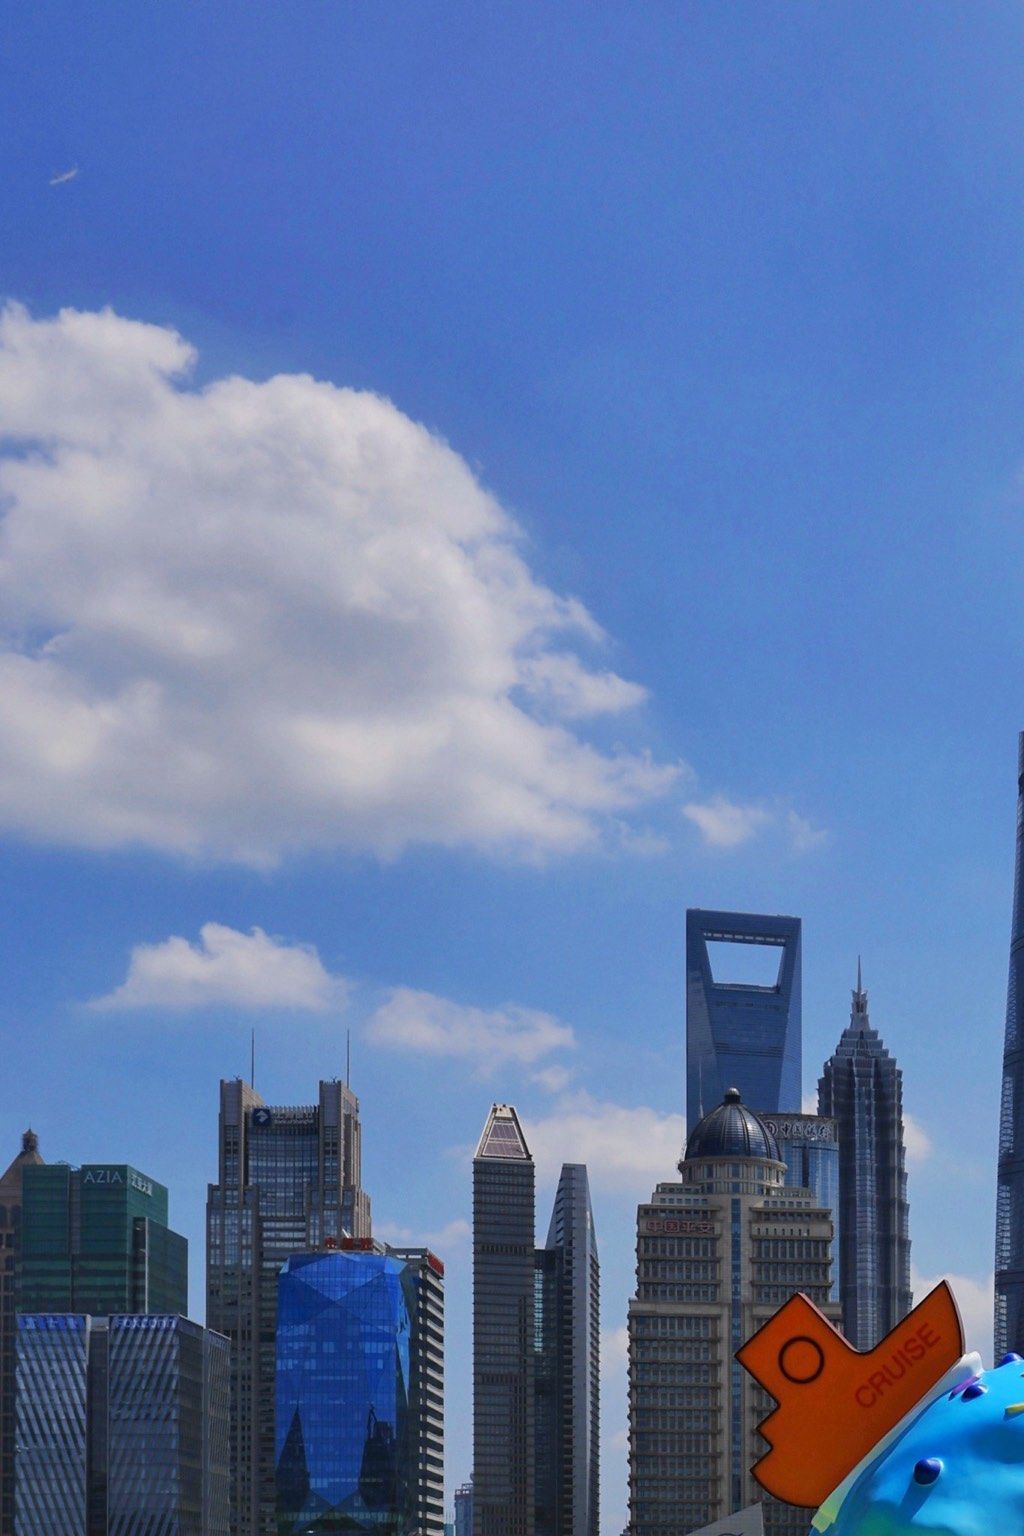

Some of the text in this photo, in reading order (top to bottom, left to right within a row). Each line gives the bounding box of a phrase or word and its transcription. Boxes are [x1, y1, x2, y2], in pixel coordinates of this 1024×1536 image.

[83, 1169, 123, 1184] AZIA
[646, 1220, 714, 1234] 中国平安
[855, 1322, 941, 1408] CRUISE
